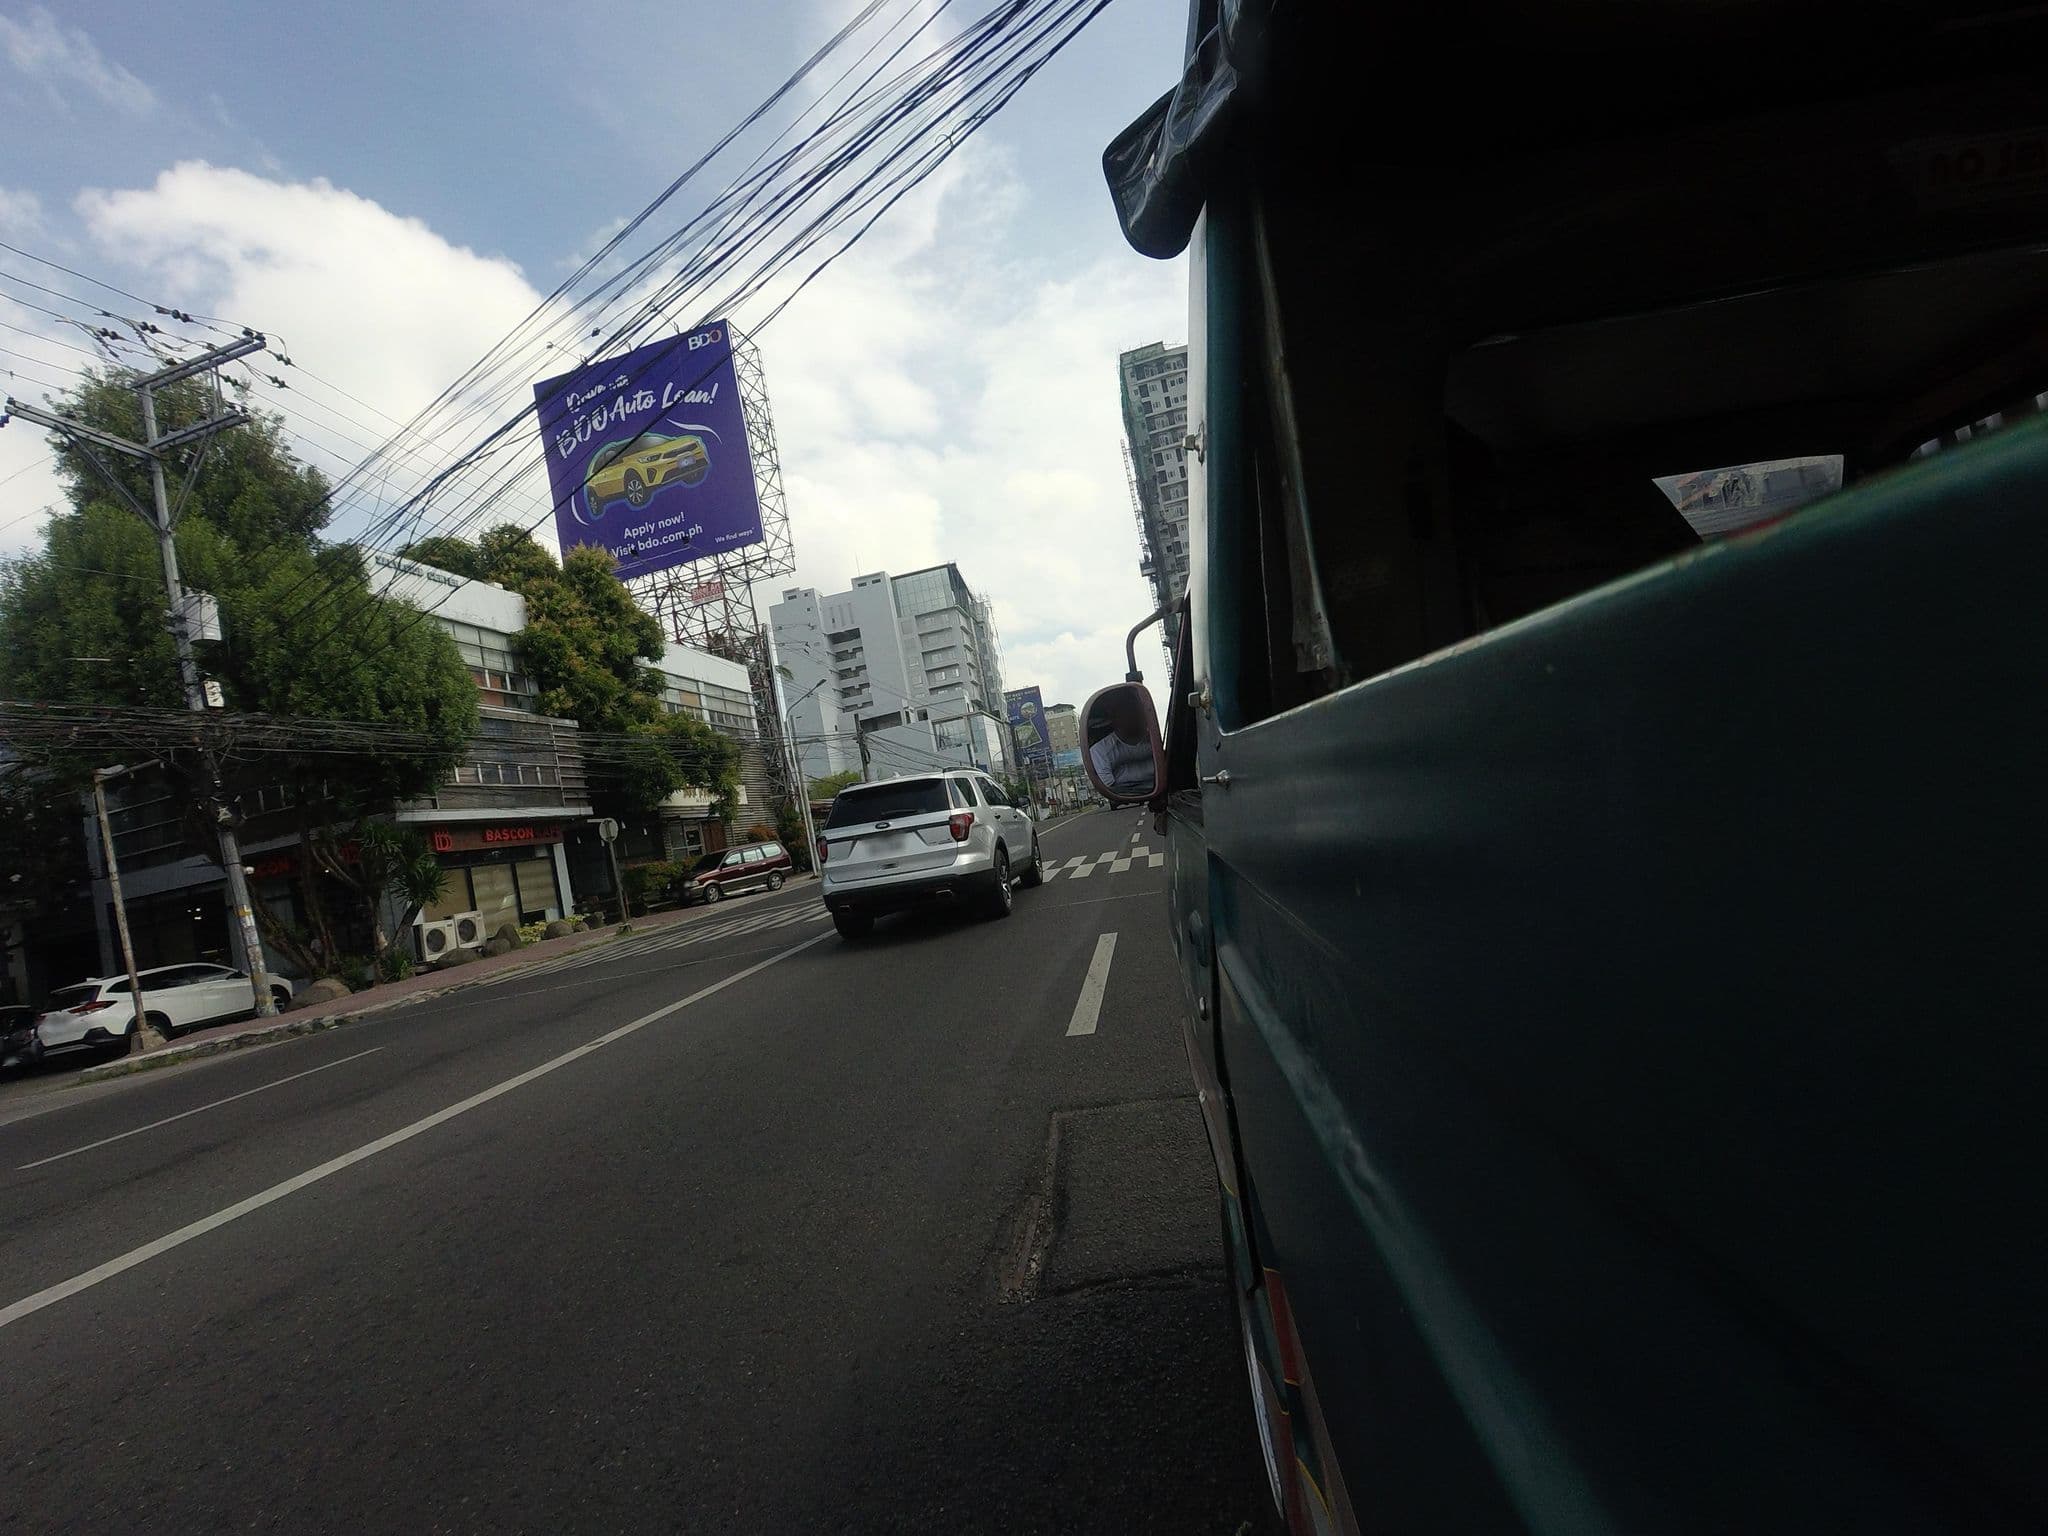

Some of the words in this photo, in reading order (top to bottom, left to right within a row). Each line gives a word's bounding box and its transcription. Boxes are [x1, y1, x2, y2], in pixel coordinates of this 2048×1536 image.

[687, 328, 722, 351] BDO
[556, 404, 608, 459] BDO
[609, 389, 656, 422] Auto
[661, 382, 719, 410] Loan!
[623, 521, 656, 539] Apply
[658, 511, 685, 529] now!
[611, 543, 636, 558] Visit
[637, 523, 703, 551] bdo.com.ph
[714, 535, 725, 544] We
[725, 532, 738, 541] find
[485, 827, 534, 841] BASCON
